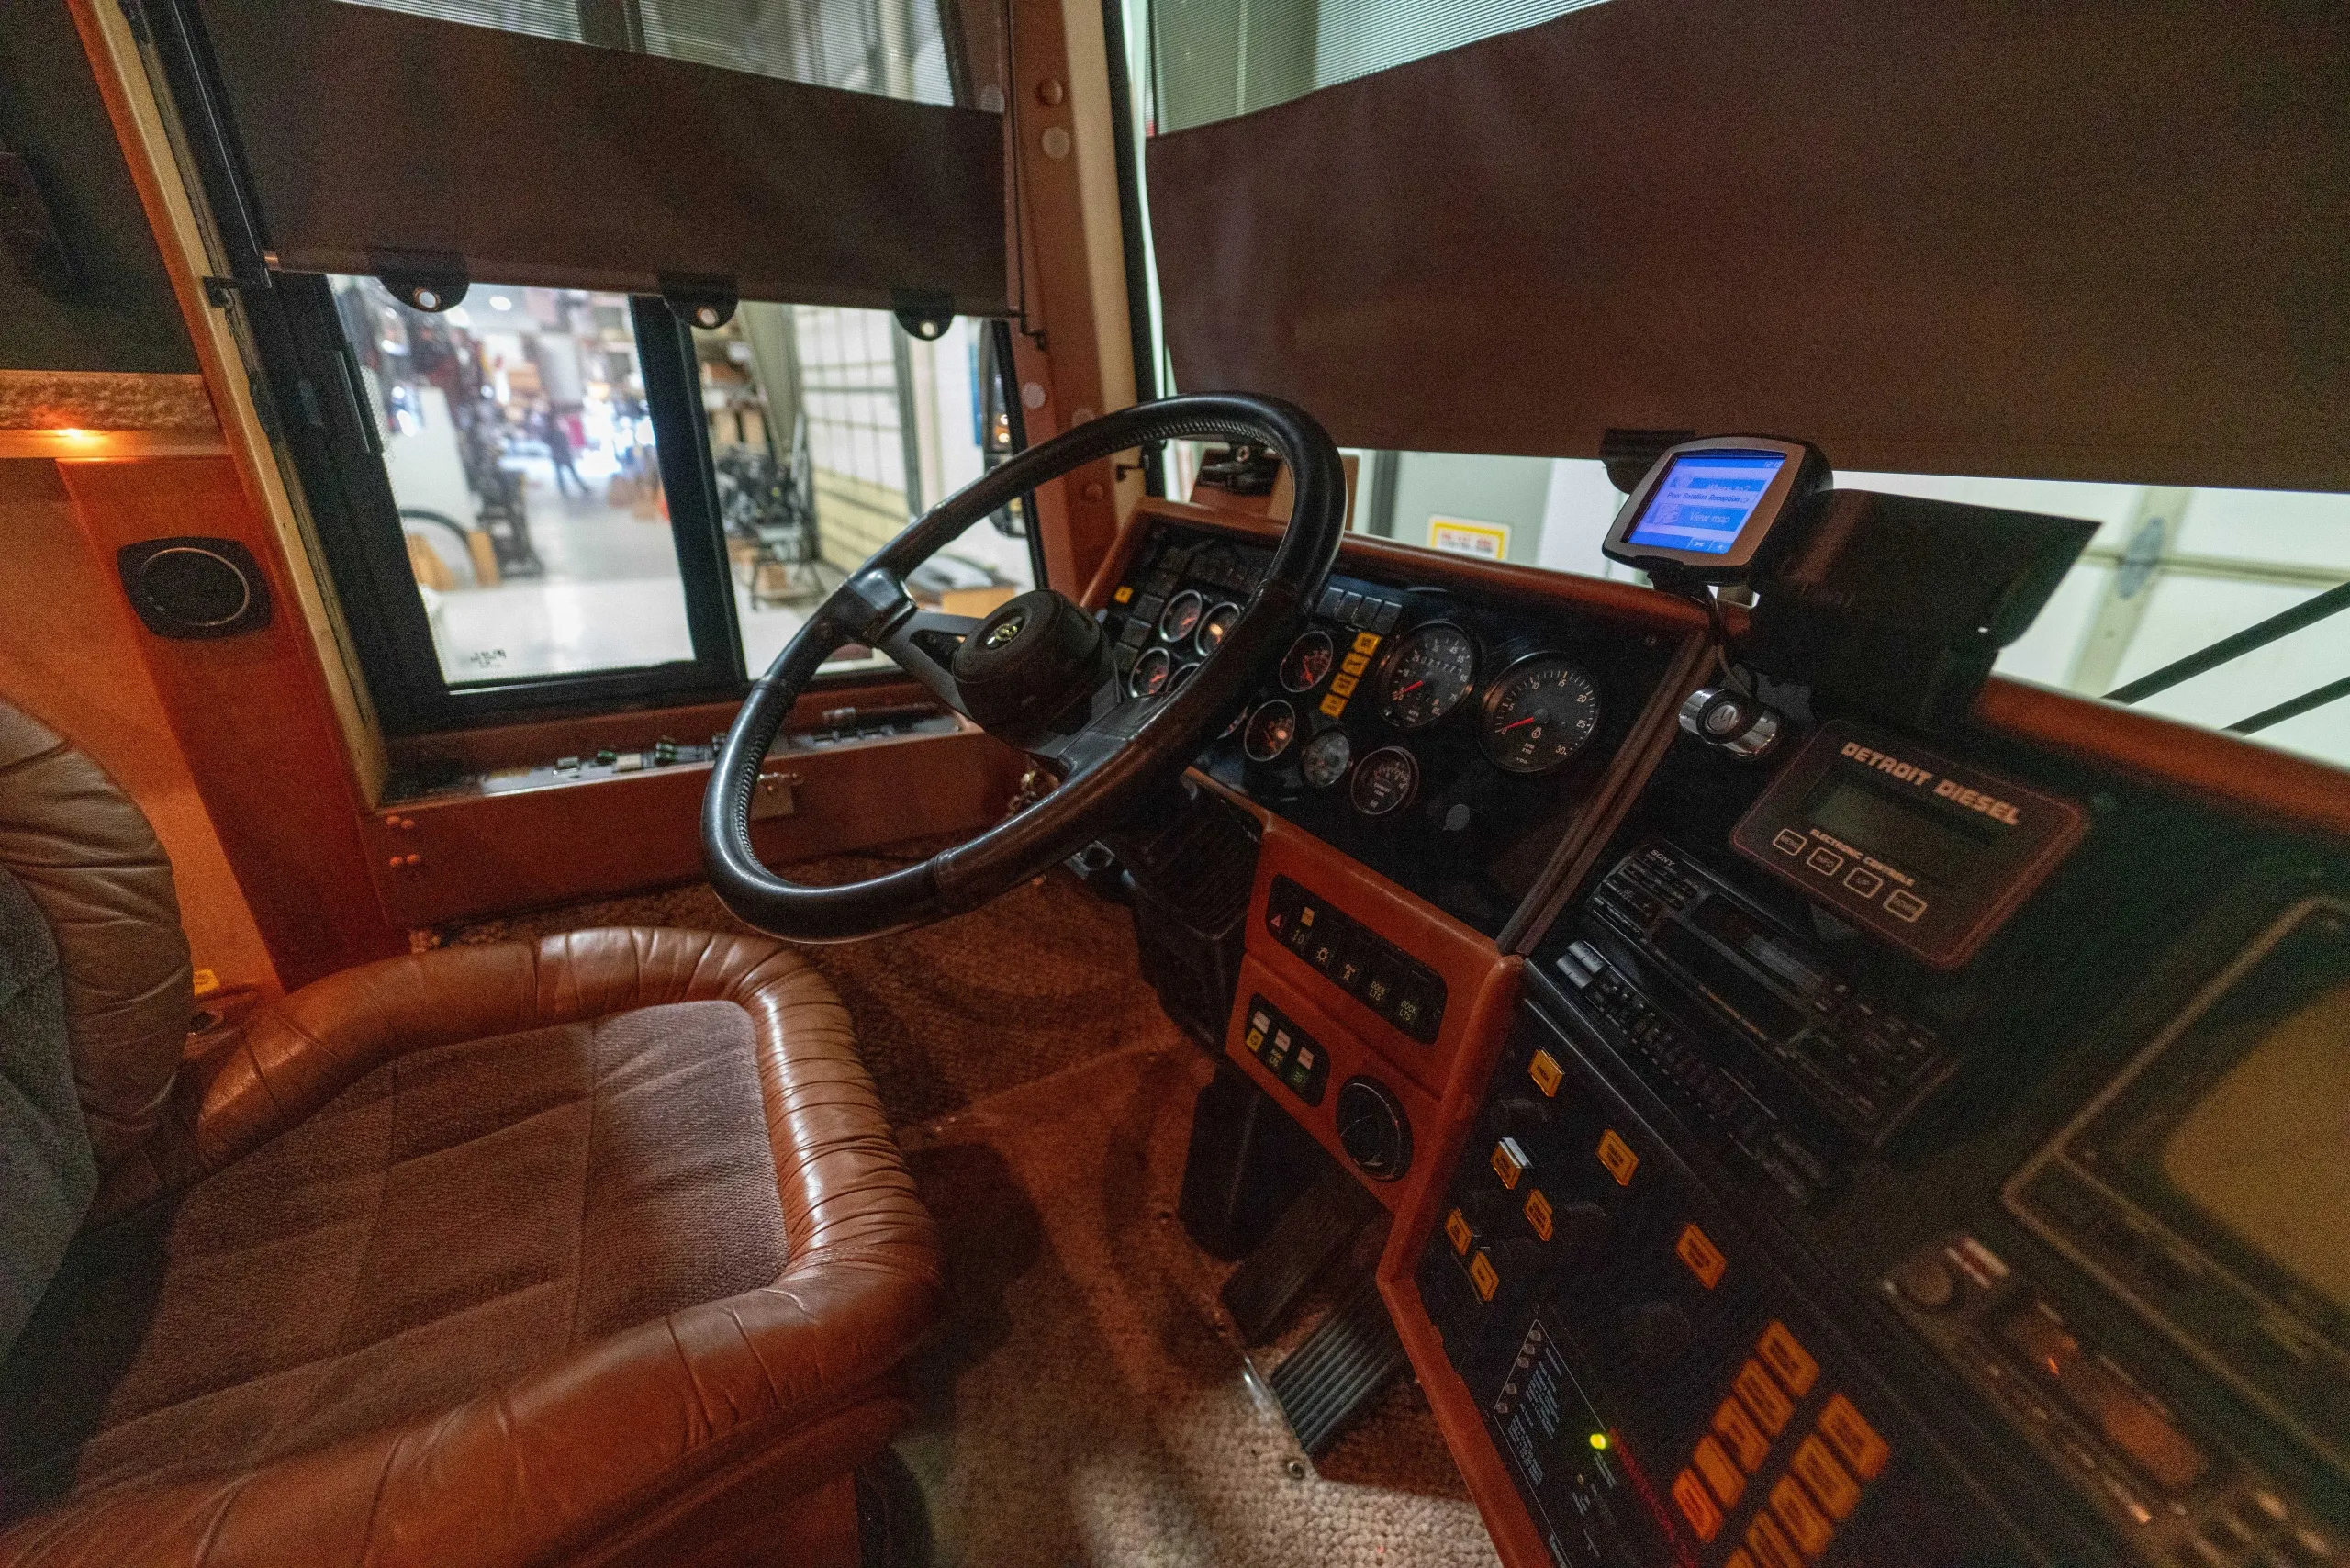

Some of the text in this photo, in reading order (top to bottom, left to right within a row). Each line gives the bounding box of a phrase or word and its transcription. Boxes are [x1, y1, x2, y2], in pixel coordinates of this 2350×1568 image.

[1682, 492, 1707, 500] Satellite
[1708, 494, 1740, 503] Reception
[1689, 511, 1730, 524] View map
[1577, 694, 1587, 703] 20
[1576, 720, 1586, 729] 25
[1555, 745, 1566, 755] 30
[1841, 742, 2020, 826] DETROIT DIESEL
[1650, 847, 1675, 868] SONY
[1369, 989, 1382, 1002] LTS
[1399, 1008, 1411, 1022] LTS
